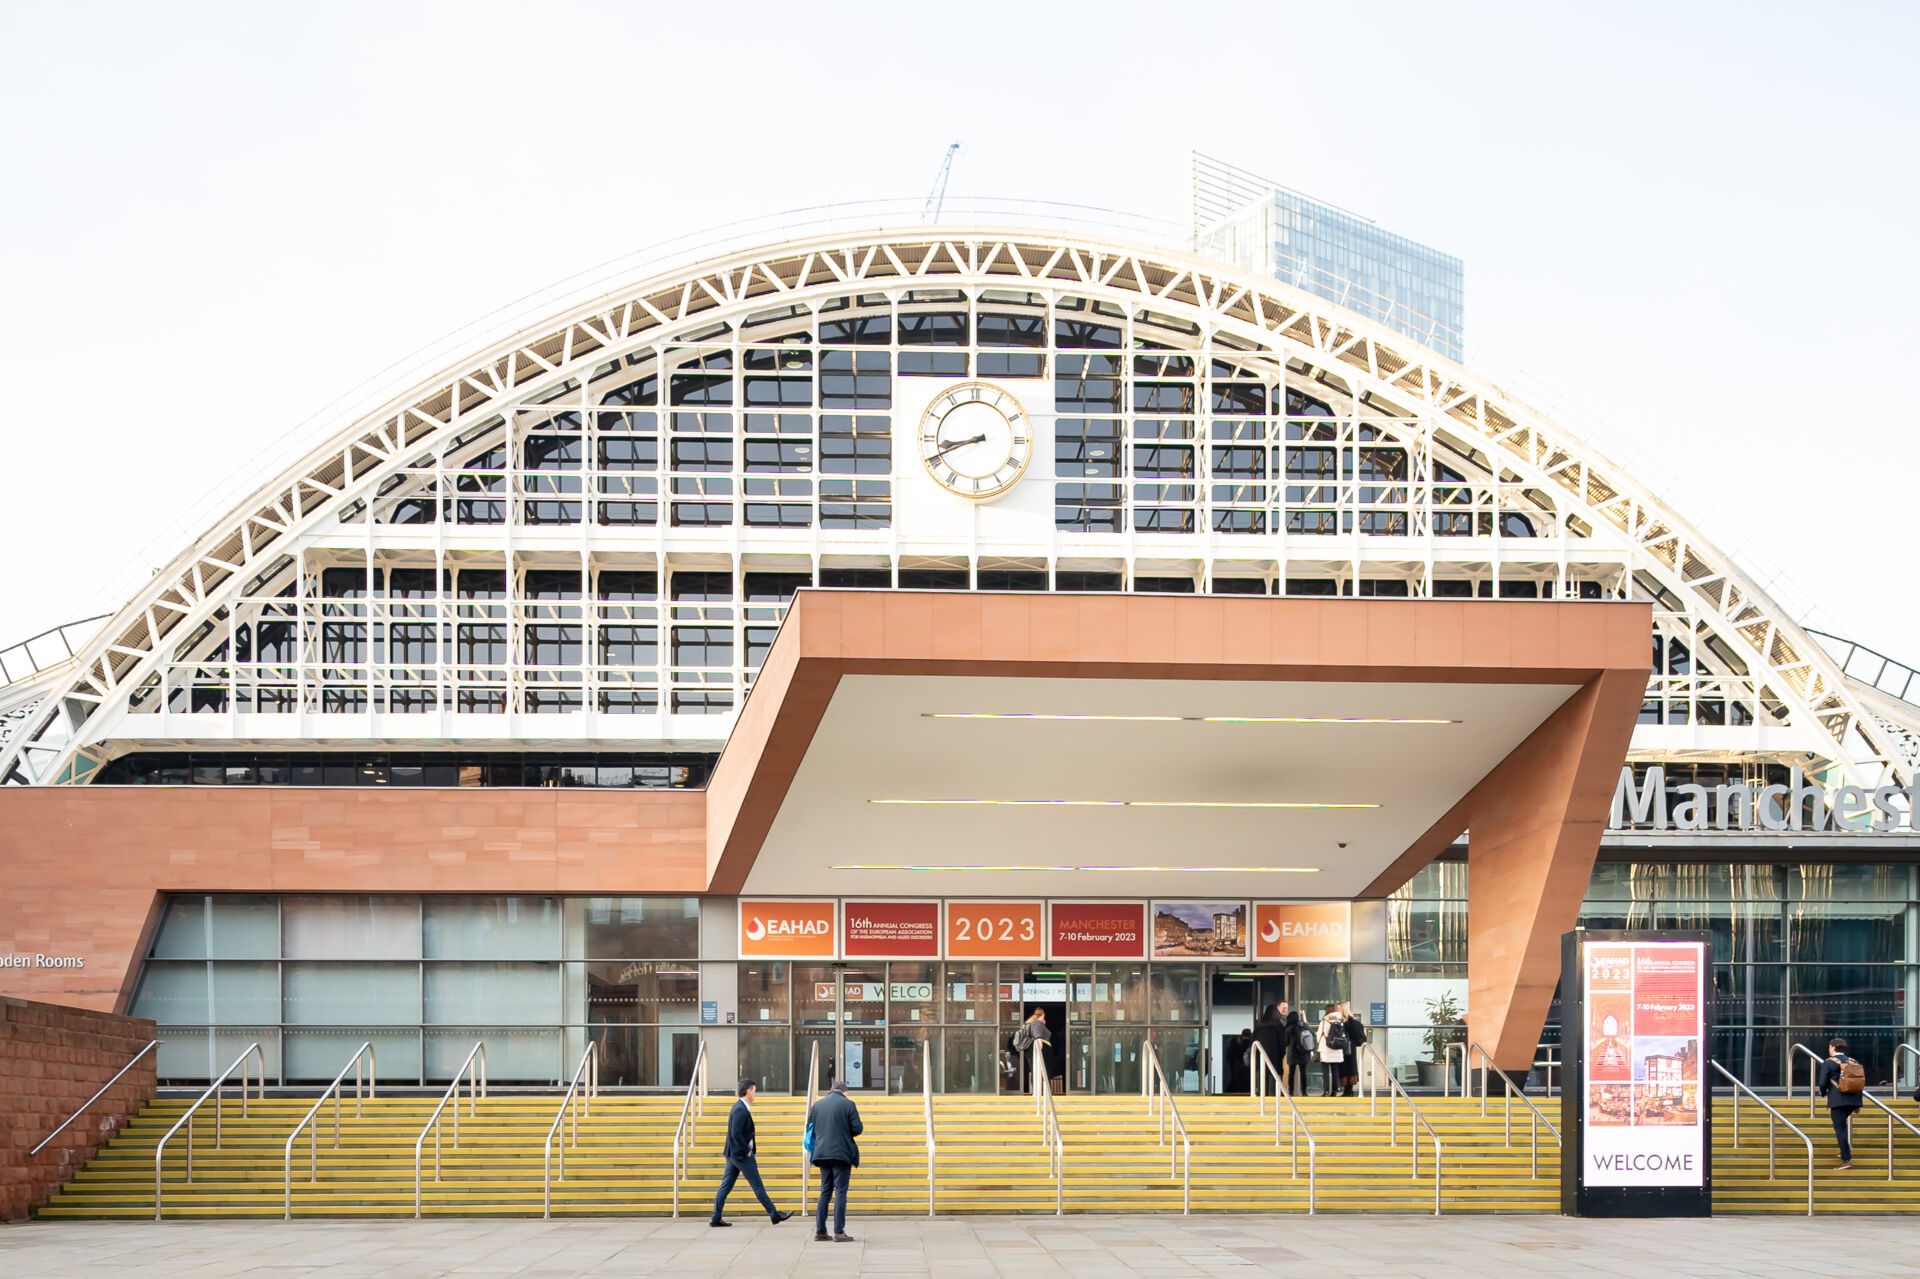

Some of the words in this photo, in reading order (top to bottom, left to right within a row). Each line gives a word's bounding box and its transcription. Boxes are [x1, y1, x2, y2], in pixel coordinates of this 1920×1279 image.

[767, 919, 829, 935] EAHAD
[850, 917, 872, 929] 16th
[955, 917, 1035, 941] 2023
[1059, 919, 1136, 930] MANCHESTER
[1281, 921, 1343, 937] EAHAD
[1059, 932, 1076, 941] 7-10
[1077, 932, 1113, 943] February
[1114, 932, 1136, 941] 2023
[35, 953, 85, 968] Rooms
[1591, 968, 1630, 980] 2023
[1593, 1154, 1693, 1171] WELCOME
